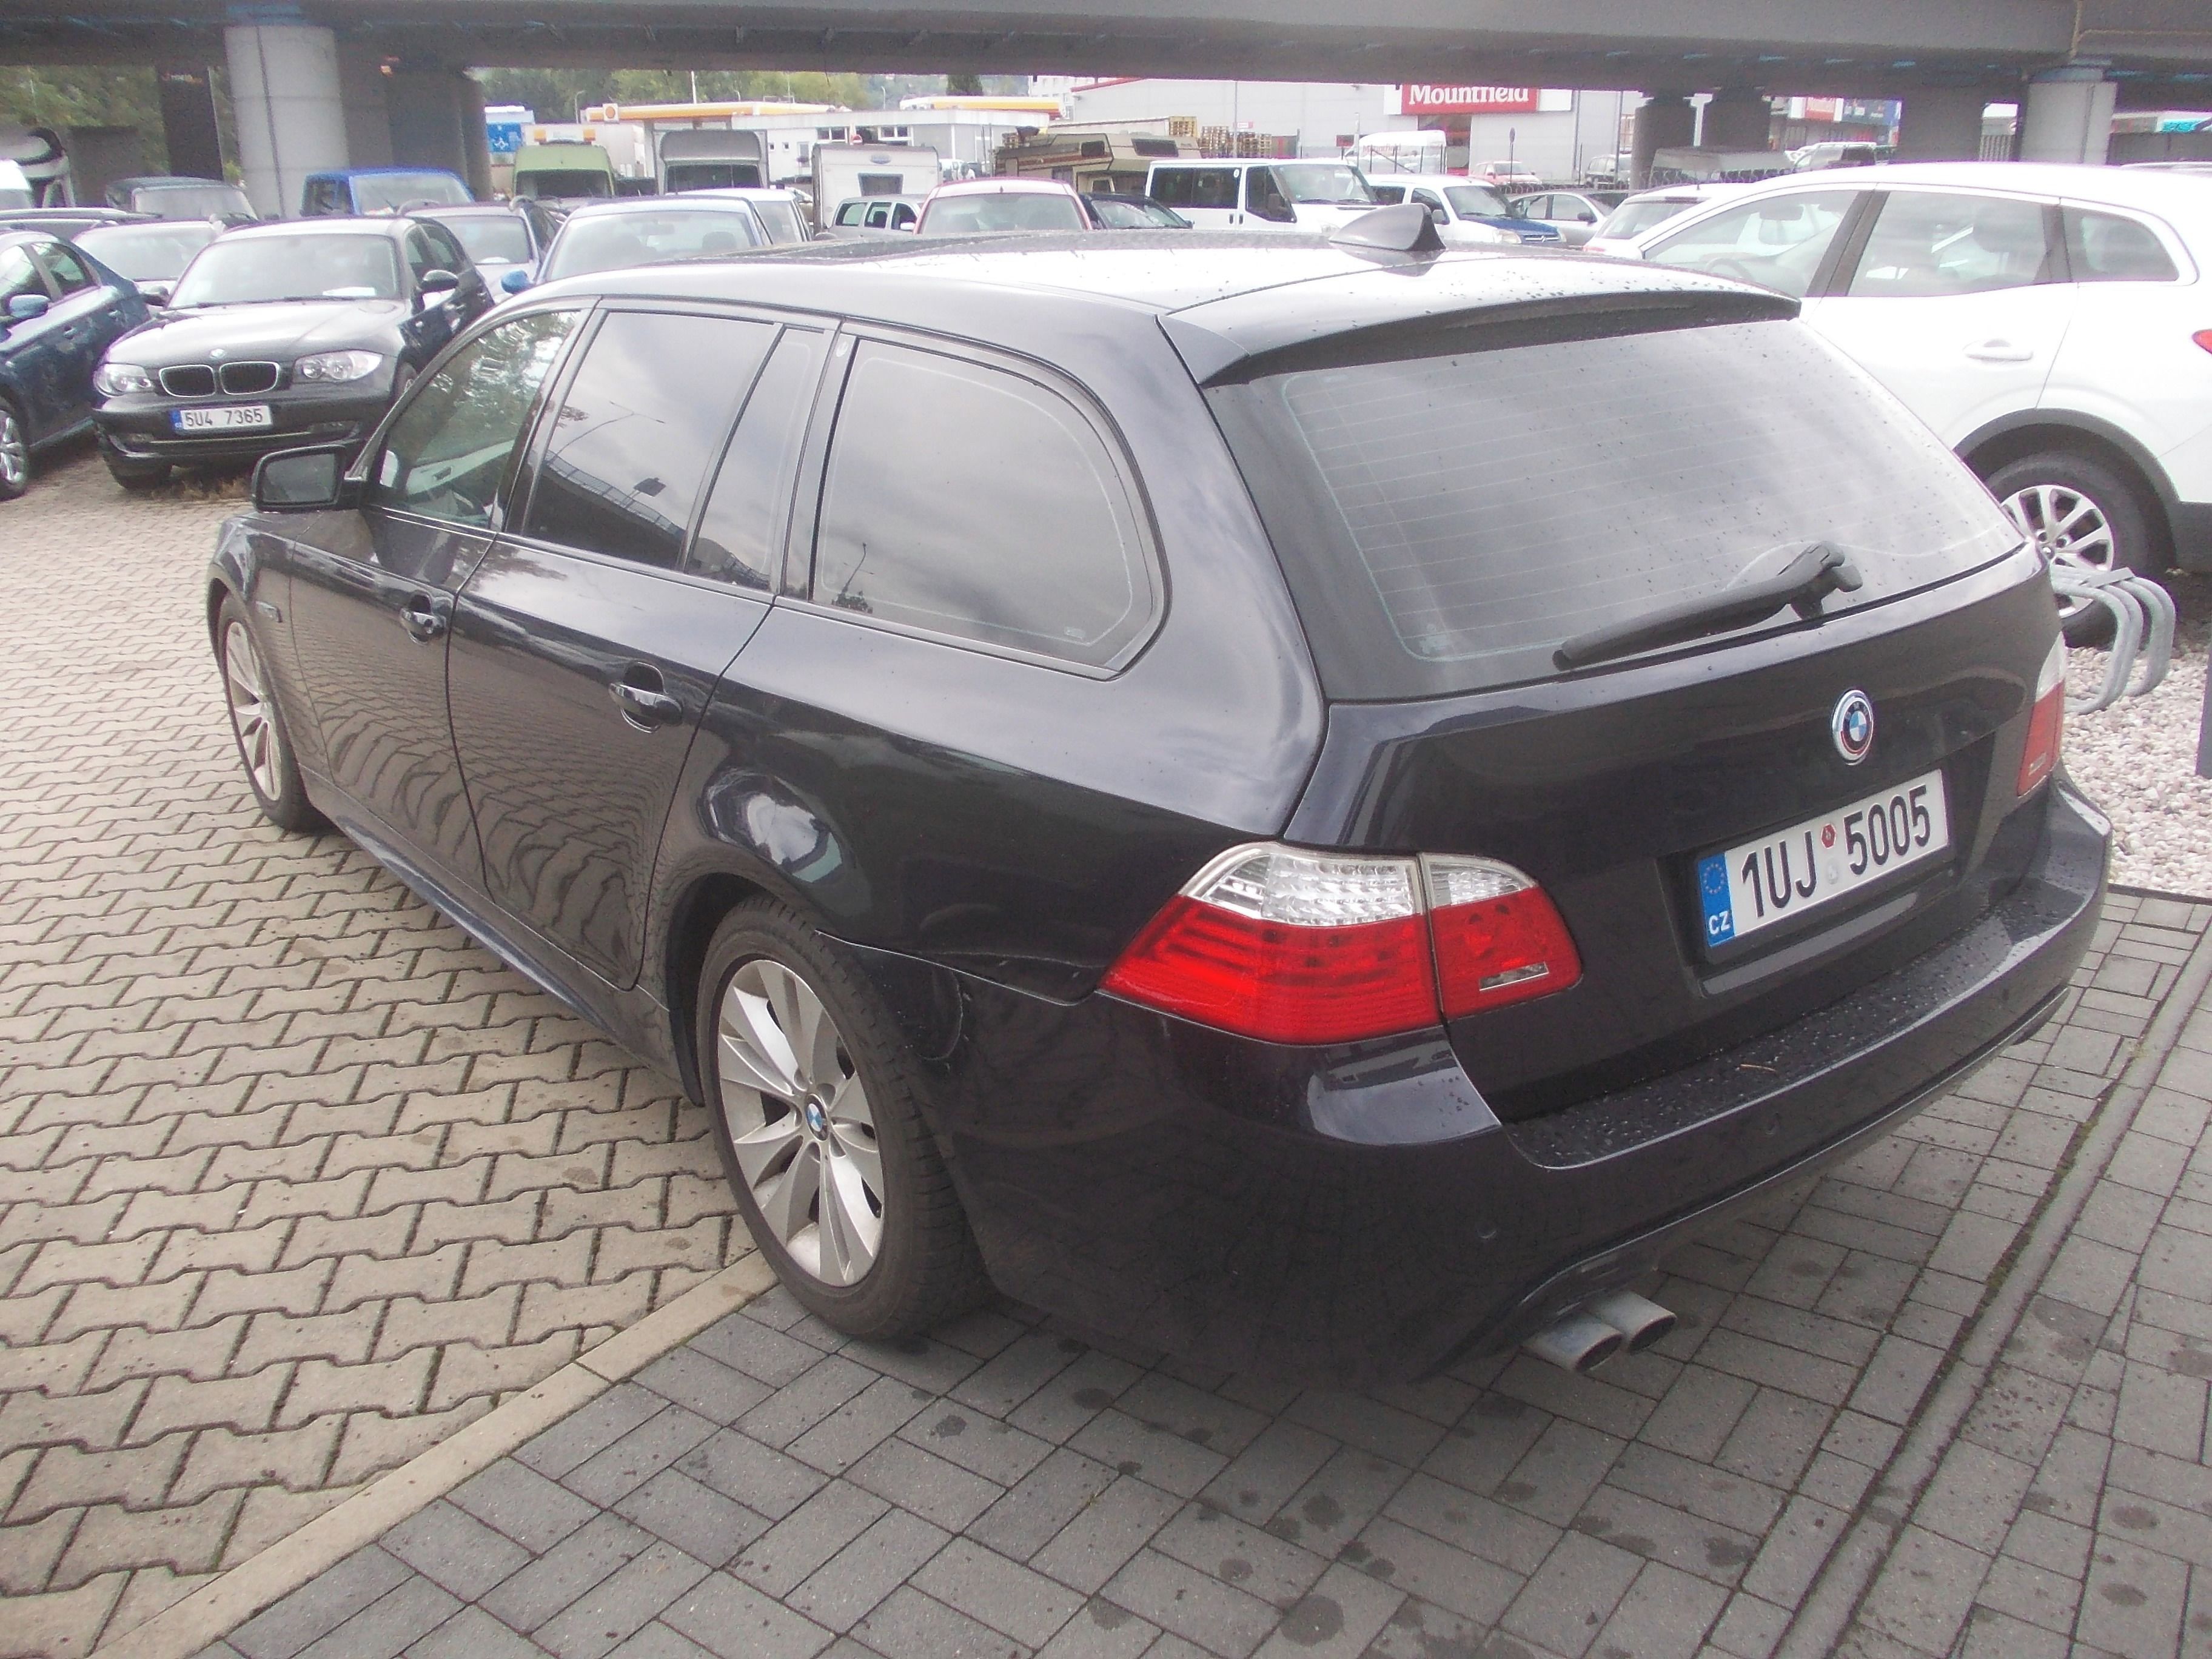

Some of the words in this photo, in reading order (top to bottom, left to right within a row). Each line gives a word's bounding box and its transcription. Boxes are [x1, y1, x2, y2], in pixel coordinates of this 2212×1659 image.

[184, 411, 213, 426] 5U4
[224, 408, 263, 425] 7365
[1741, 830, 1817, 918] 1UJ
[1843, 784, 1931, 876] 5005
[1708, 910, 1731, 935] CZ
